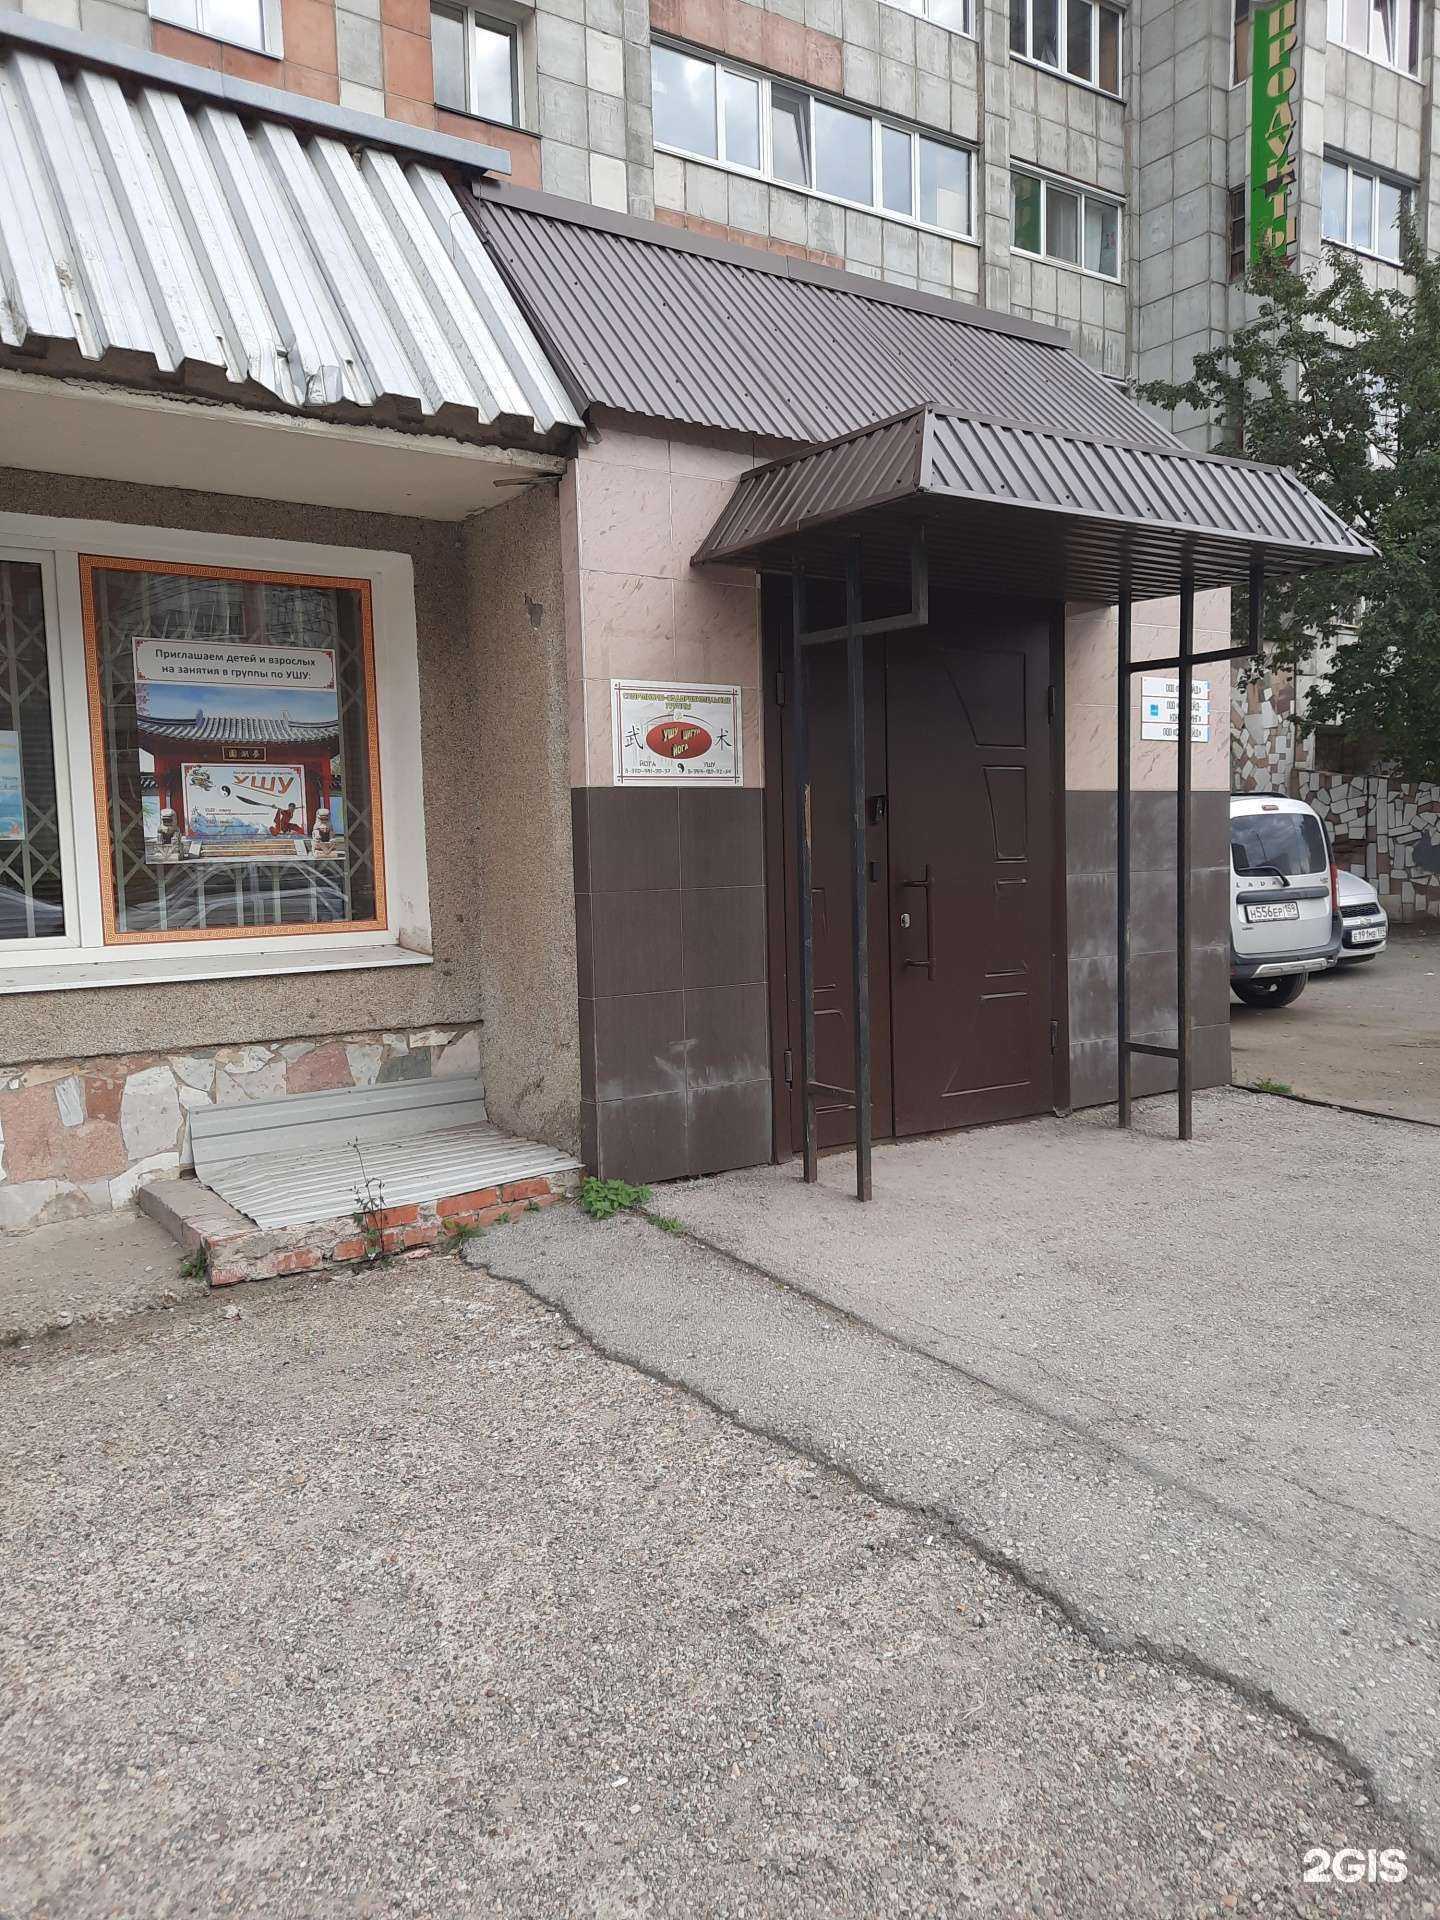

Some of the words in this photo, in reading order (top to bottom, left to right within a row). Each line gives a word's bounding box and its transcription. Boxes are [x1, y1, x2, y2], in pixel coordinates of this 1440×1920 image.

[155, 648, 224, 662] Приглашаем
[226, 654, 257, 664] детей
[268, 658, 316, 667] взрослых
[162, 666, 175, 674] на
[177, 667, 220, 675] занятия
[231, 670, 268, 680] группы
[270, 671, 283, 679] по
[663, 727, 679, 742] УШУ
[673, 744, 689, 758] ЙОГА
[233, 775, 295, 795] УШУ
